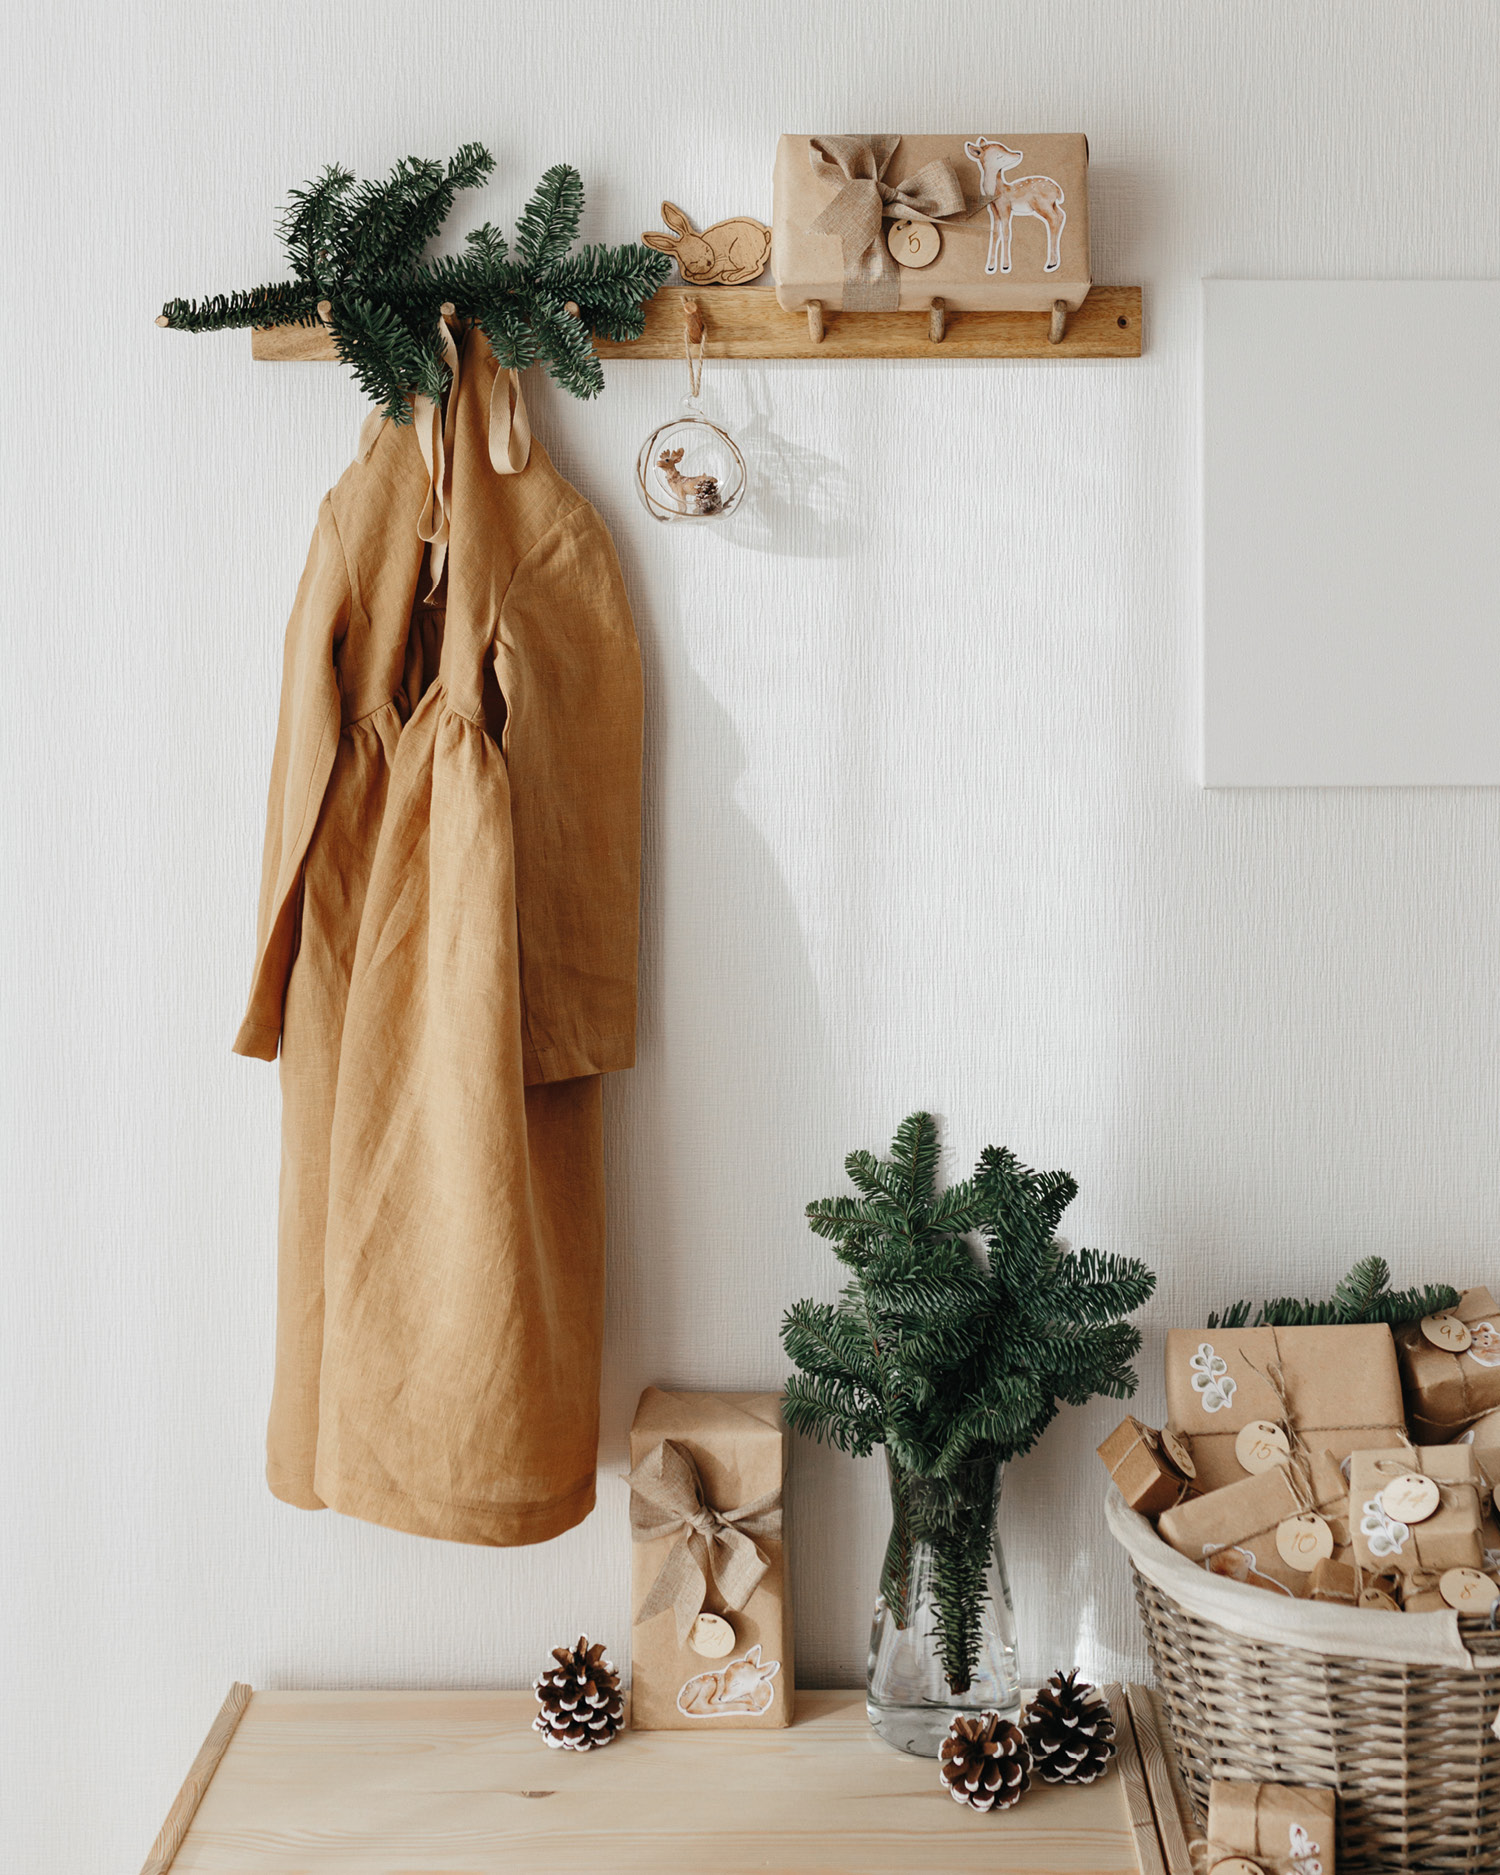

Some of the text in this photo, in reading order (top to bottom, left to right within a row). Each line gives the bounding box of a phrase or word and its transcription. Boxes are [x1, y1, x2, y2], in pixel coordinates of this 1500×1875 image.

[907, 230, 921, 254] 5
[1439, 1324, 1452, 1341] 9
[1248, 1439, 1277, 1461] 15
[1396, 1490, 1428, 1509] 14
[1290, 1531, 1318, 1553] 10
